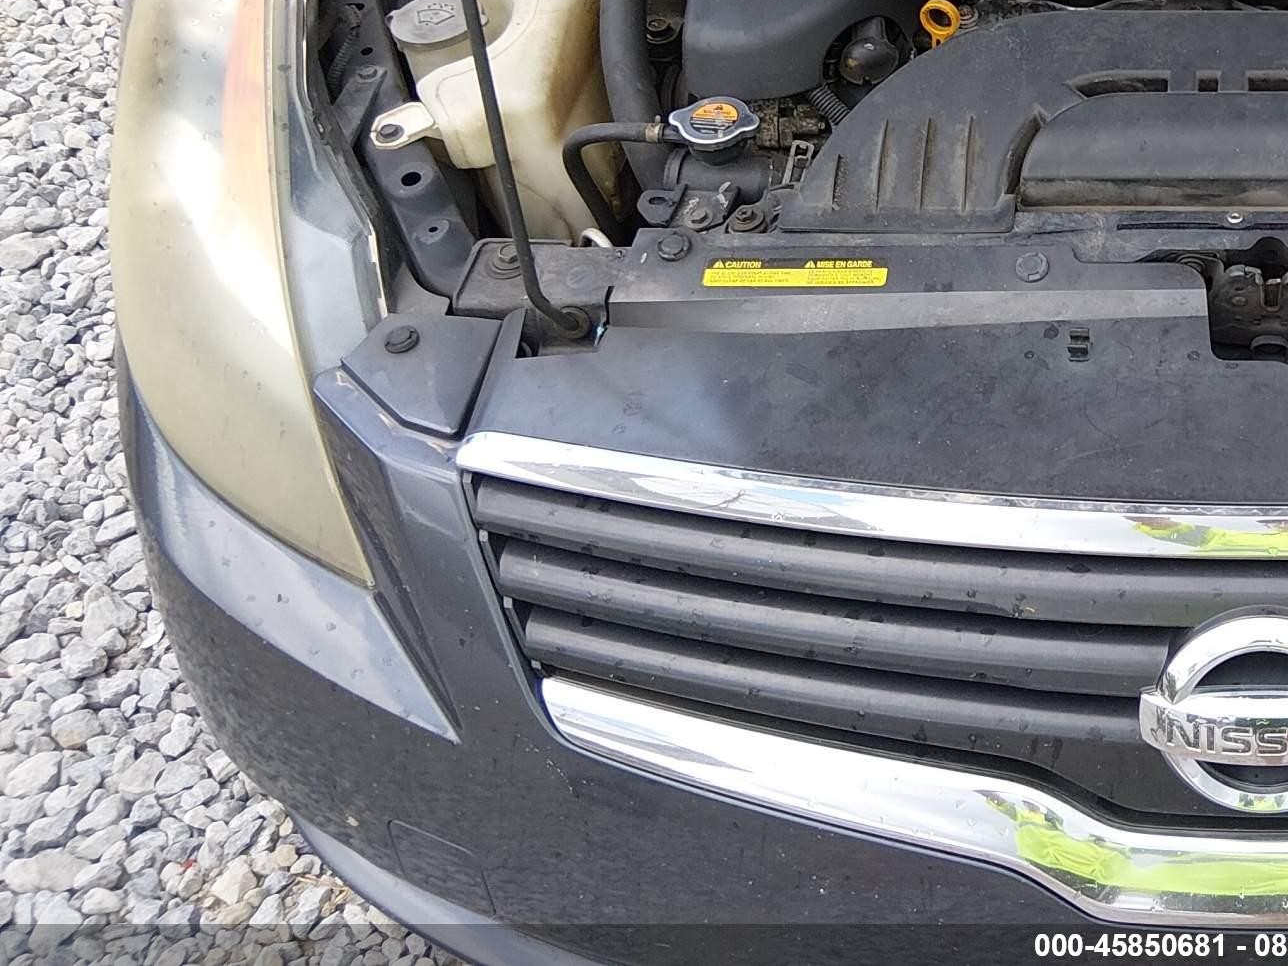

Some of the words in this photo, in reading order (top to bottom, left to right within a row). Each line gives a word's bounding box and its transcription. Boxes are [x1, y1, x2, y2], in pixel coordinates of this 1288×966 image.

[725, 260, 762, 268] CAUTION
[816, 260, 834, 268] MISE
[835, 260, 847, 268] EN
[847, 260, 872, 268] GARDE
